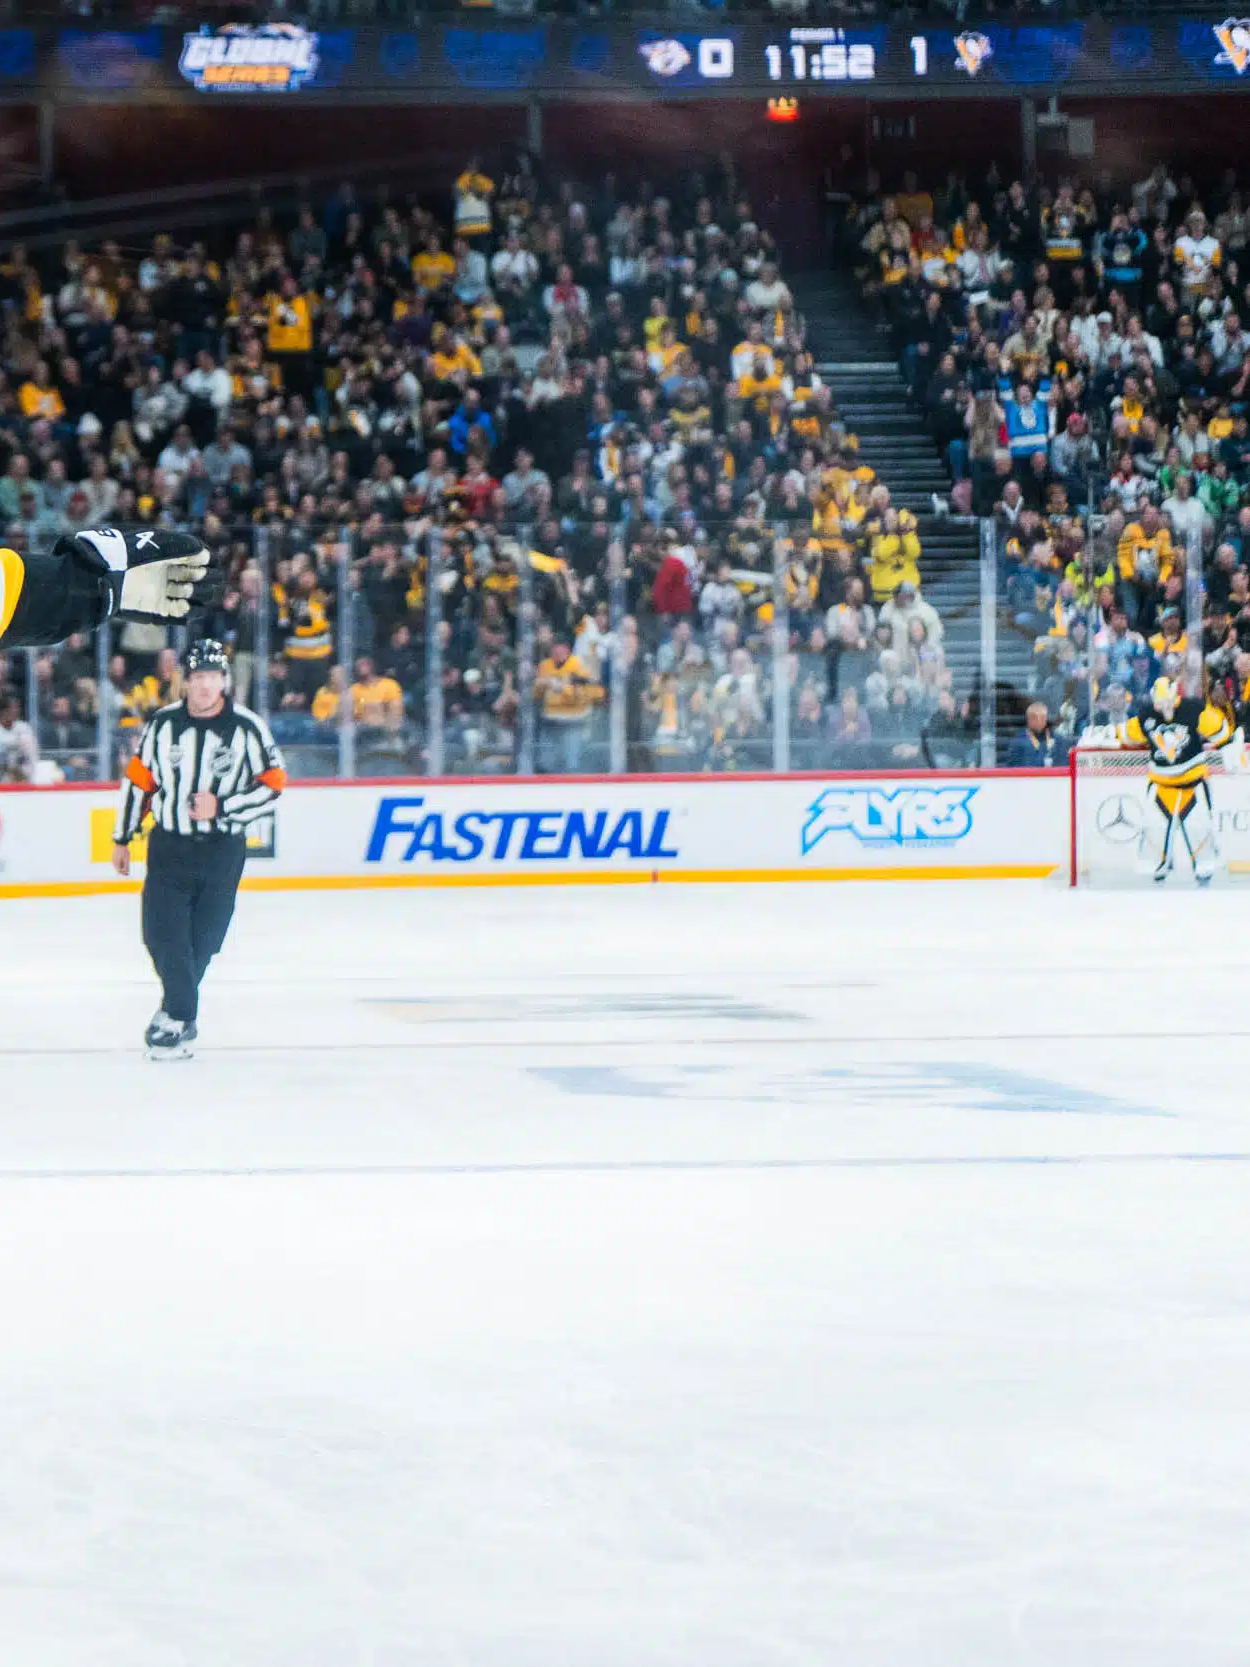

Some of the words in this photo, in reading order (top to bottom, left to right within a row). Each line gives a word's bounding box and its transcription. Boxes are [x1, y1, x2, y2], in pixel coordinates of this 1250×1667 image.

[698, 38, 735, 78] 0
[765, 44, 876, 80] 11:52
[910, 35, 928, 76] 1
[364, 796, 679, 862] FASTENAL
